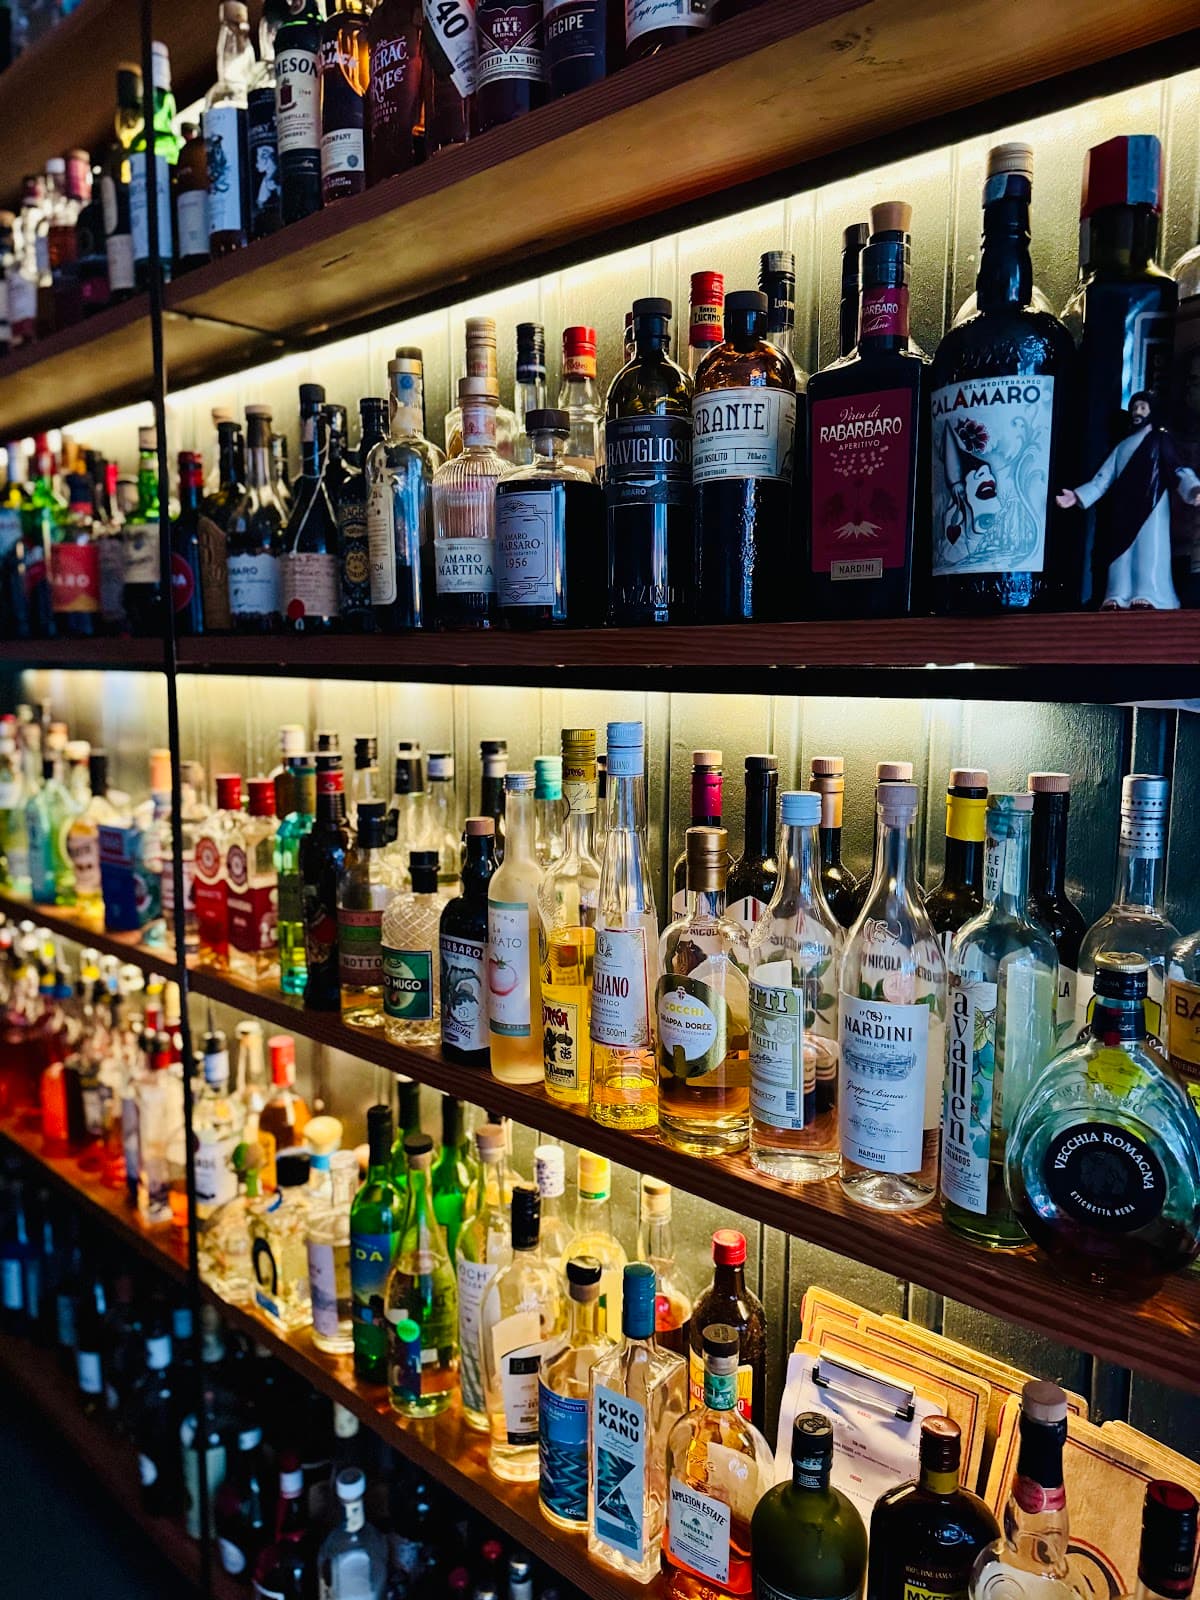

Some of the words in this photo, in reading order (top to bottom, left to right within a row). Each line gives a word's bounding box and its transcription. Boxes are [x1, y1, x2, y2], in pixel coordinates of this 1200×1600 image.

[436, 1, 469, 39] 40
[493, 21, 522, 35] RYE
[548, 14, 585, 40] RECIPE
[867, 404, 881, 418] di
[819, 416, 903, 444] RABARBARO
[838, 439, 881, 451] APERITIVO
[438, 564, 494, 577] MARTINA
[443, 553, 482, 564] AMARO
[505, 558, 528, 569] 1956
[838, 562, 875, 575] NARDINI
[605, 1026, 628, 1038] 500ml
[844, 1014, 913, 1042] NARDINI
[949, 992, 970, 1146] avallen
[858, 1148, 886, 1161] NARDINI
[1054, 1131, 1100, 1169] VECCHIA
[1103, 1131, 1155, 1189] ROMAGNA
[1069, 1190, 1112, 1217] ETICHETTA
[1114, 1203, 1136, 1216] NERA
[598, 1397, 640, 1427] KOKO
[598, 1412, 640, 1443] KANU
[671, 1489, 701, 1510] APPLETON
[701, 1501, 728, 1526] ESTATE
